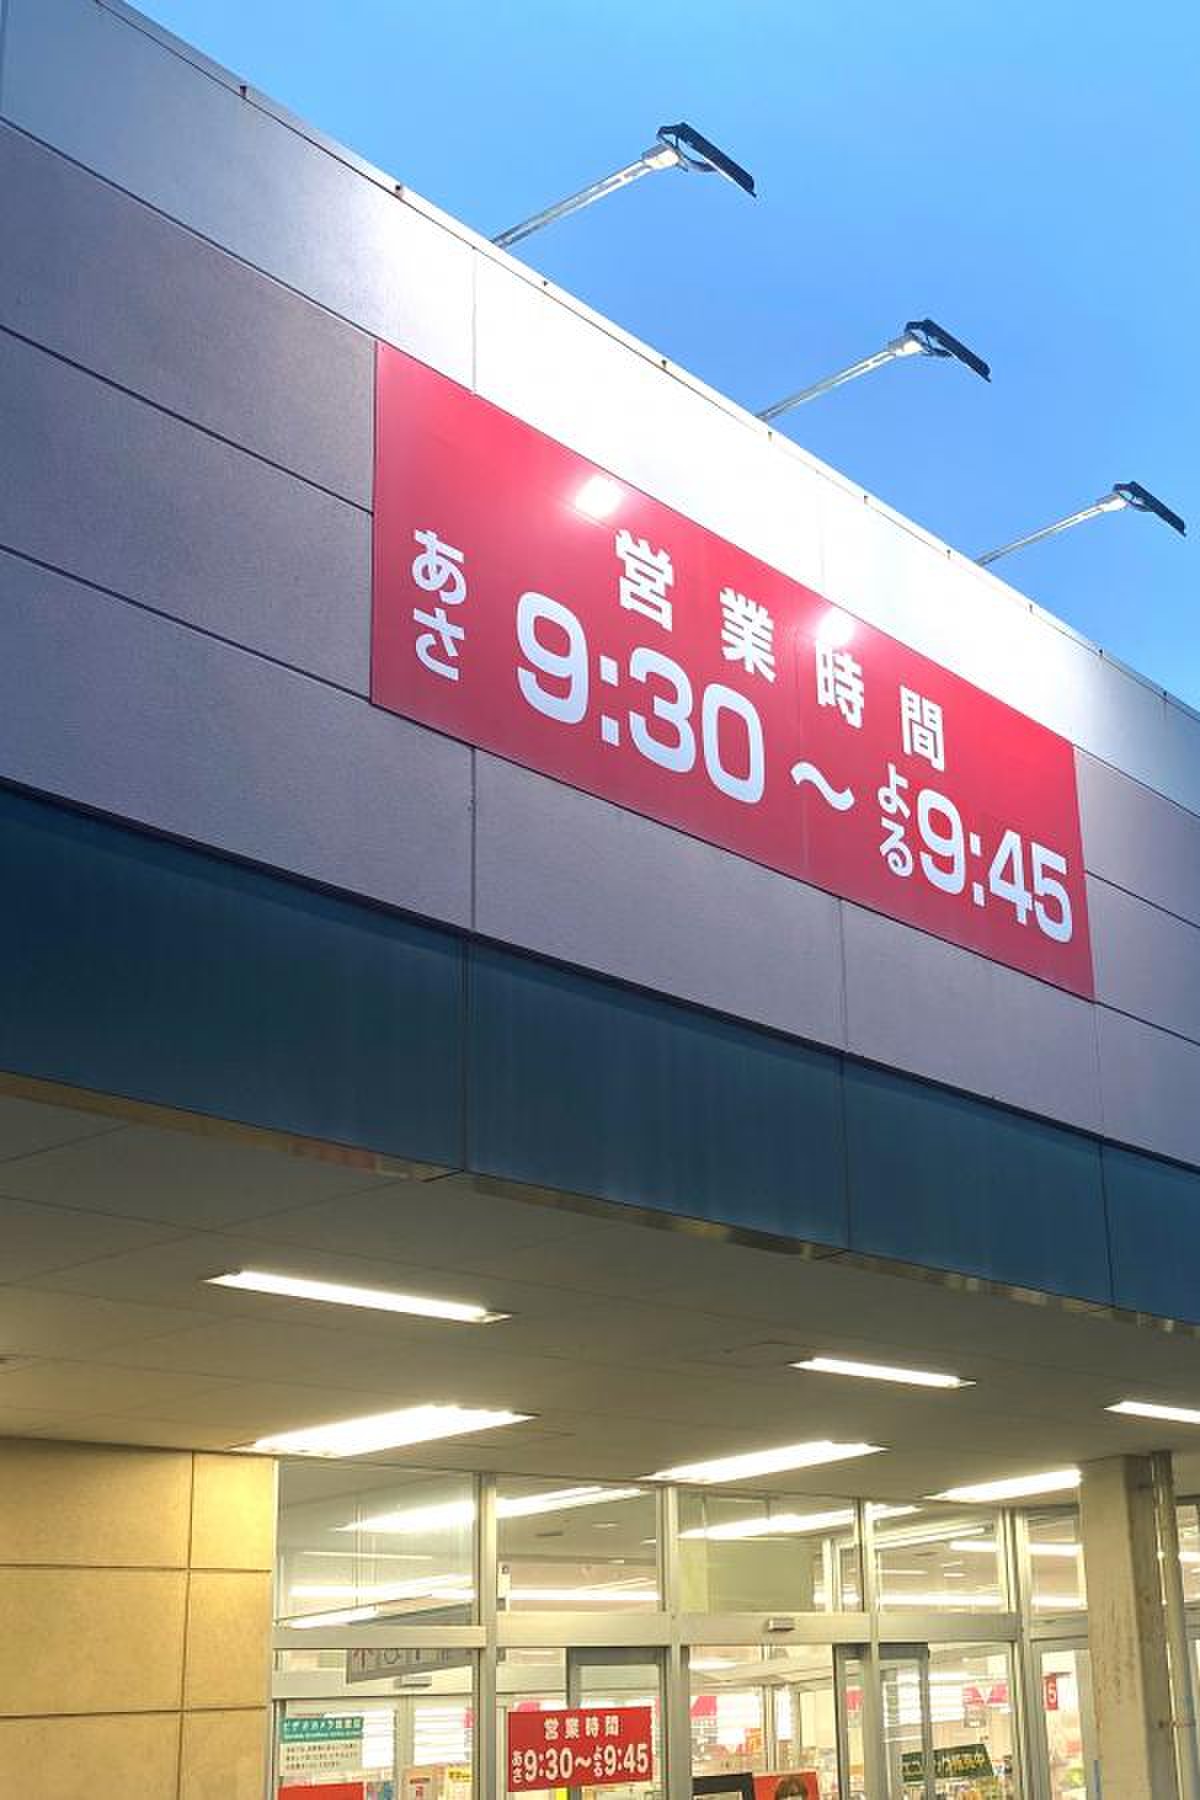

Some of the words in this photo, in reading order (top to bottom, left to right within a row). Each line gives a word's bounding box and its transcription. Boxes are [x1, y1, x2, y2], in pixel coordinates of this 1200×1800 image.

[411, 529, 465, 681] あさ
[615, 528, 945, 772] 営業時間
[877, 764, 914, 878] よる
[917, 788, 1073, 944] 9:45
[544, 1715, 619, 1740] 営業時間
[604, 1743, 649, 1776] 9:45
